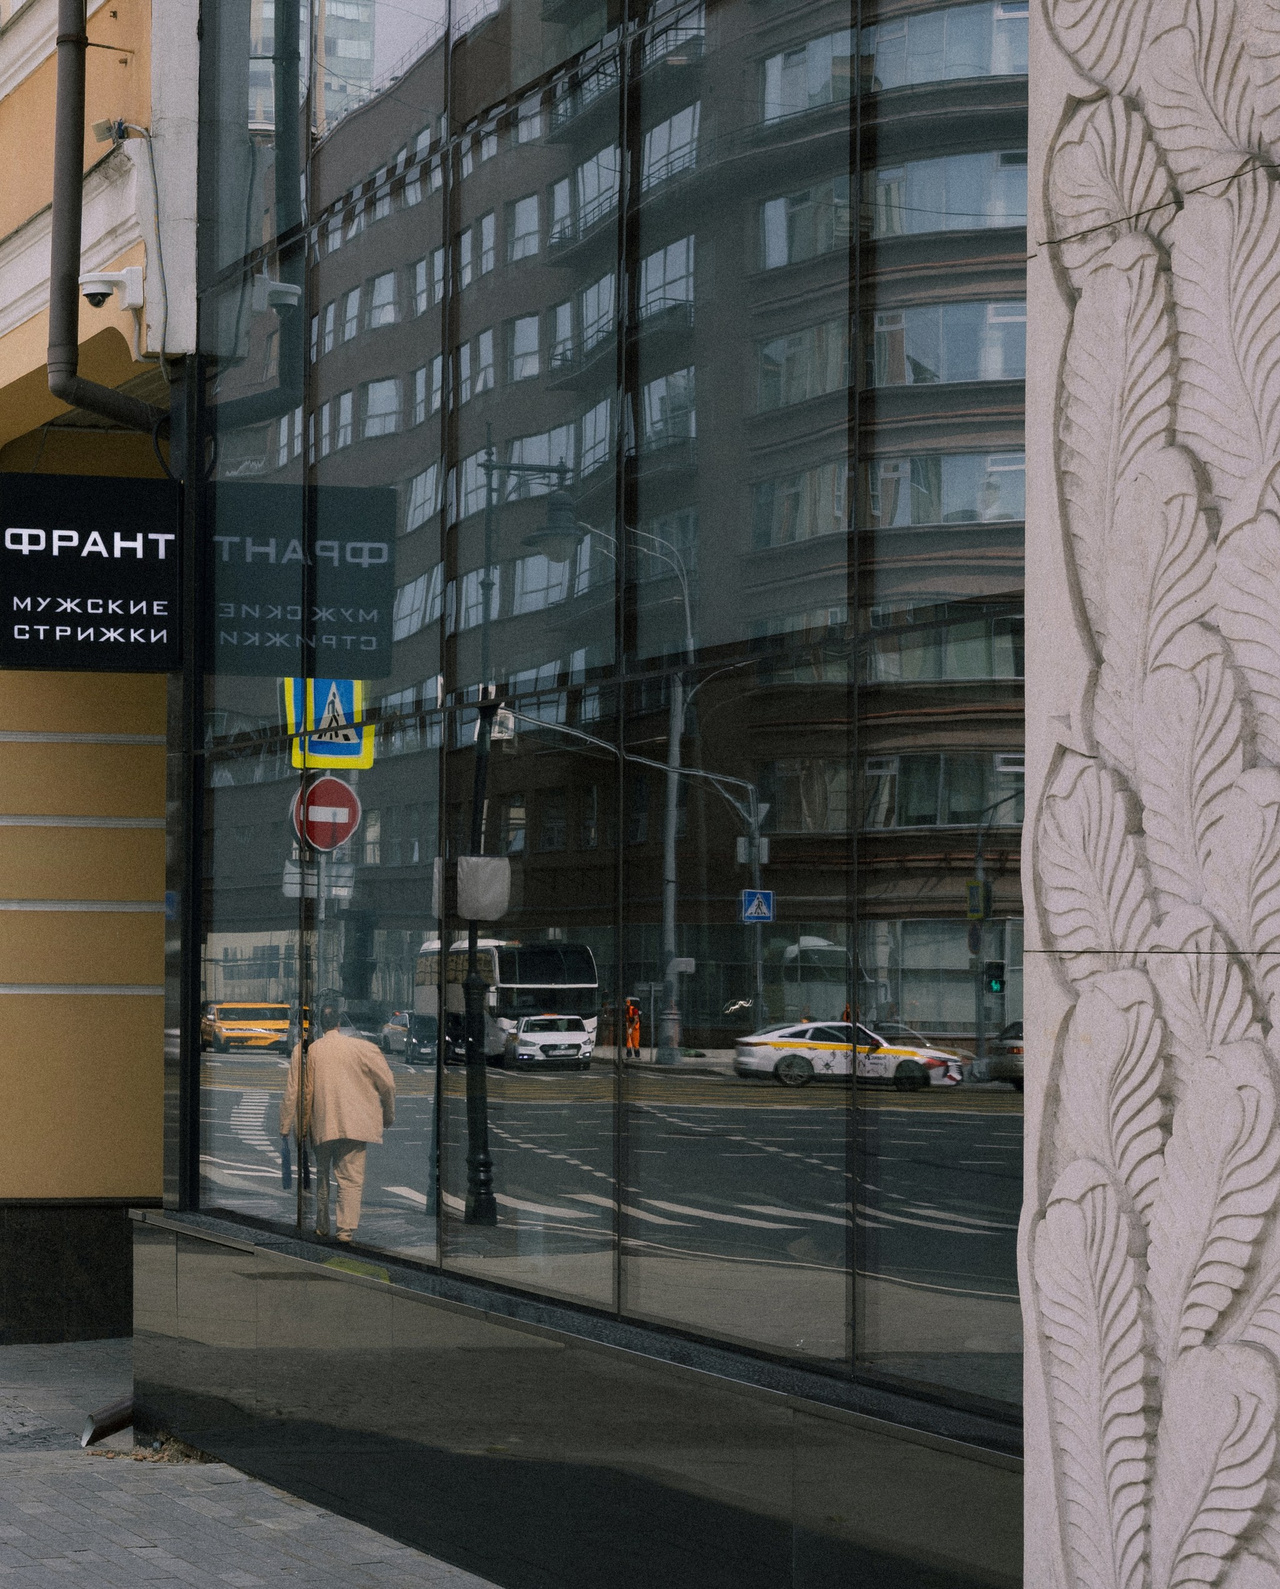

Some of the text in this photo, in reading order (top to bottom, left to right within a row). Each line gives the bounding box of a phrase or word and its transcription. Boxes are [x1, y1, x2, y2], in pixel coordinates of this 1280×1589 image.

[5, 527, 176, 560] ФРАНТ
[13, 596, 168, 616] МУЖСКИЕ
[13, 624, 168, 644] СТРИЖКИ
